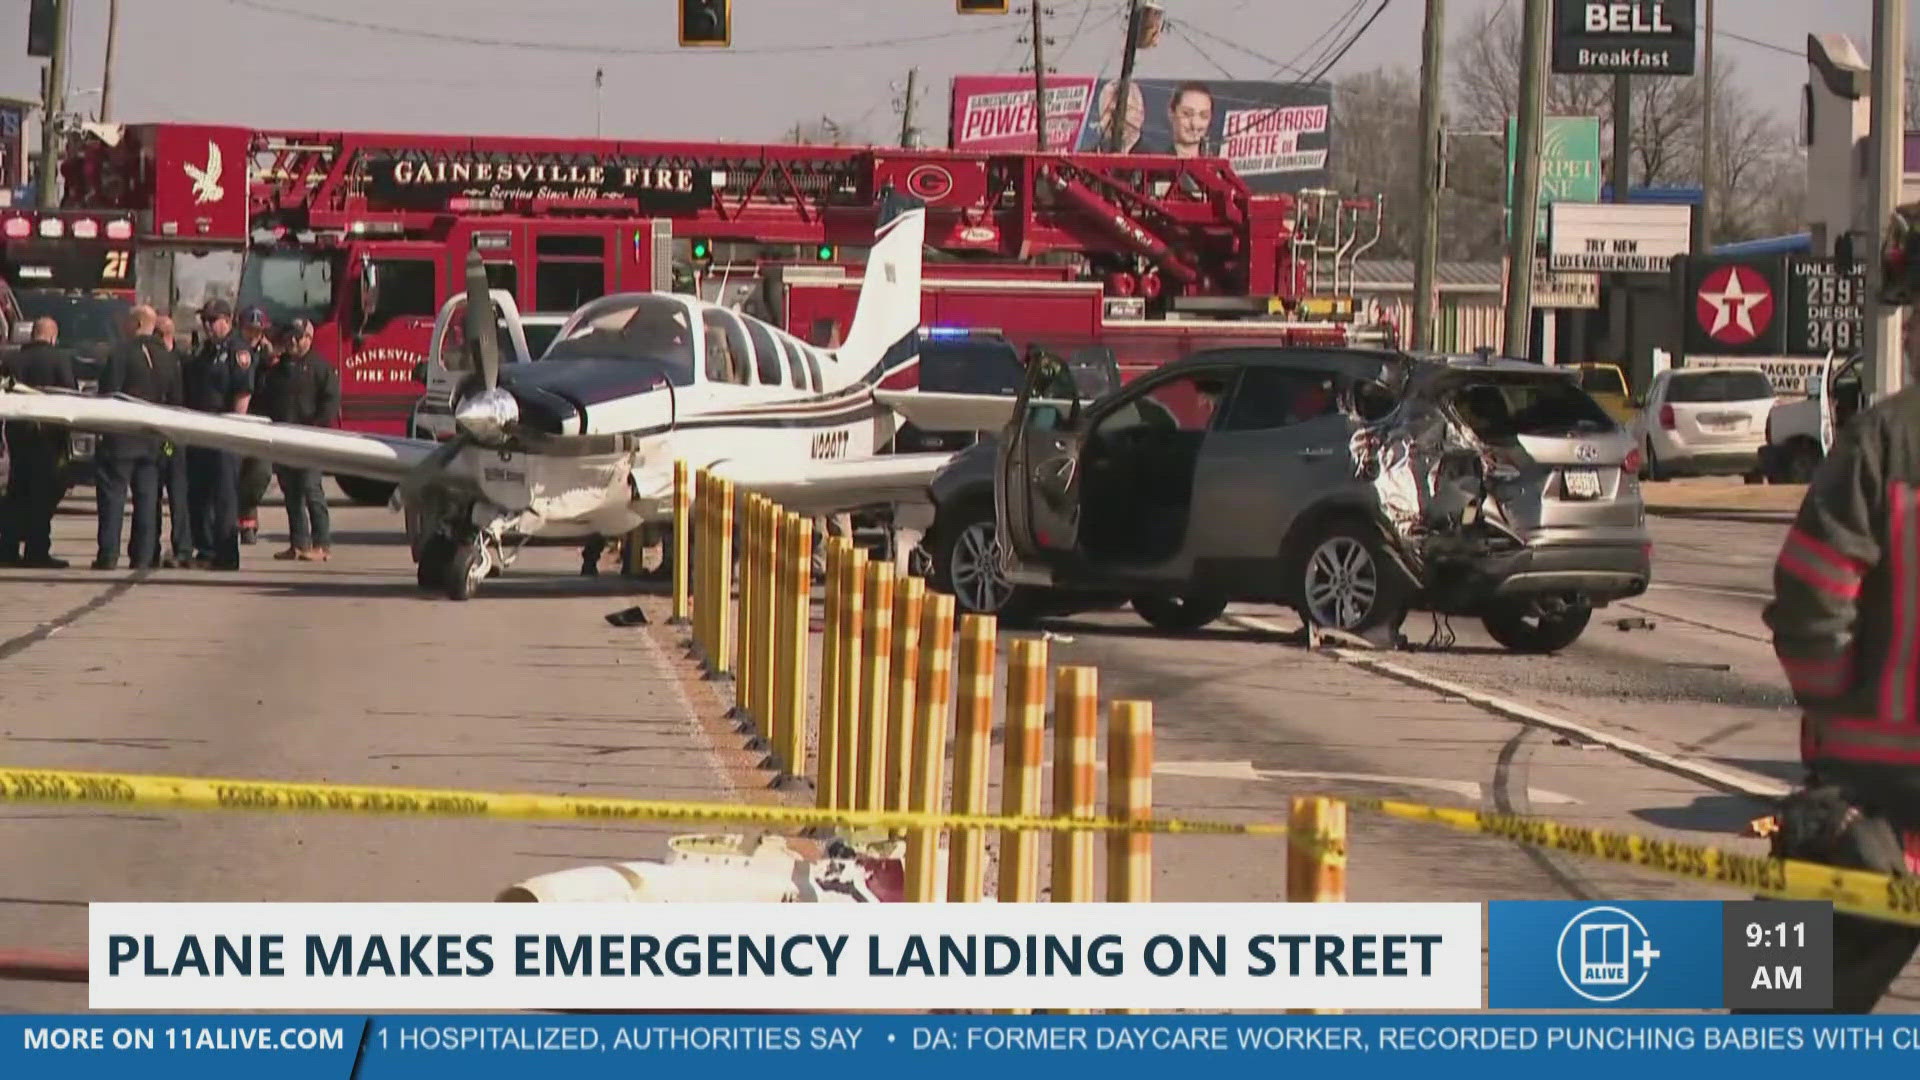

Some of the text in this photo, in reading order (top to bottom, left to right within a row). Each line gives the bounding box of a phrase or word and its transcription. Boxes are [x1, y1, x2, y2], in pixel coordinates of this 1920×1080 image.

[1585, 3, 1672, 33] BELL
[1578, 48, 1670, 67] Breakfast
[1228, 107, 1325, 134] EL PODEROSO
[1228, 134, 1278, 157] BUFETE
[393, 160, 694, 192] GAINESVILLE FIRE
[489, 184, 533, 200] Serving
[536, 185, 568, 200] Since
[1586, 239, 1638, 254] TRY NEW
[102, 251, 129, 279] 21
[1807, 277, 1851, 305] 259
[1808, 306, 1863, 320] DIESEL
[1807, 320, 1850, 349] 349
[356, 369, 385, 382] FIRE
